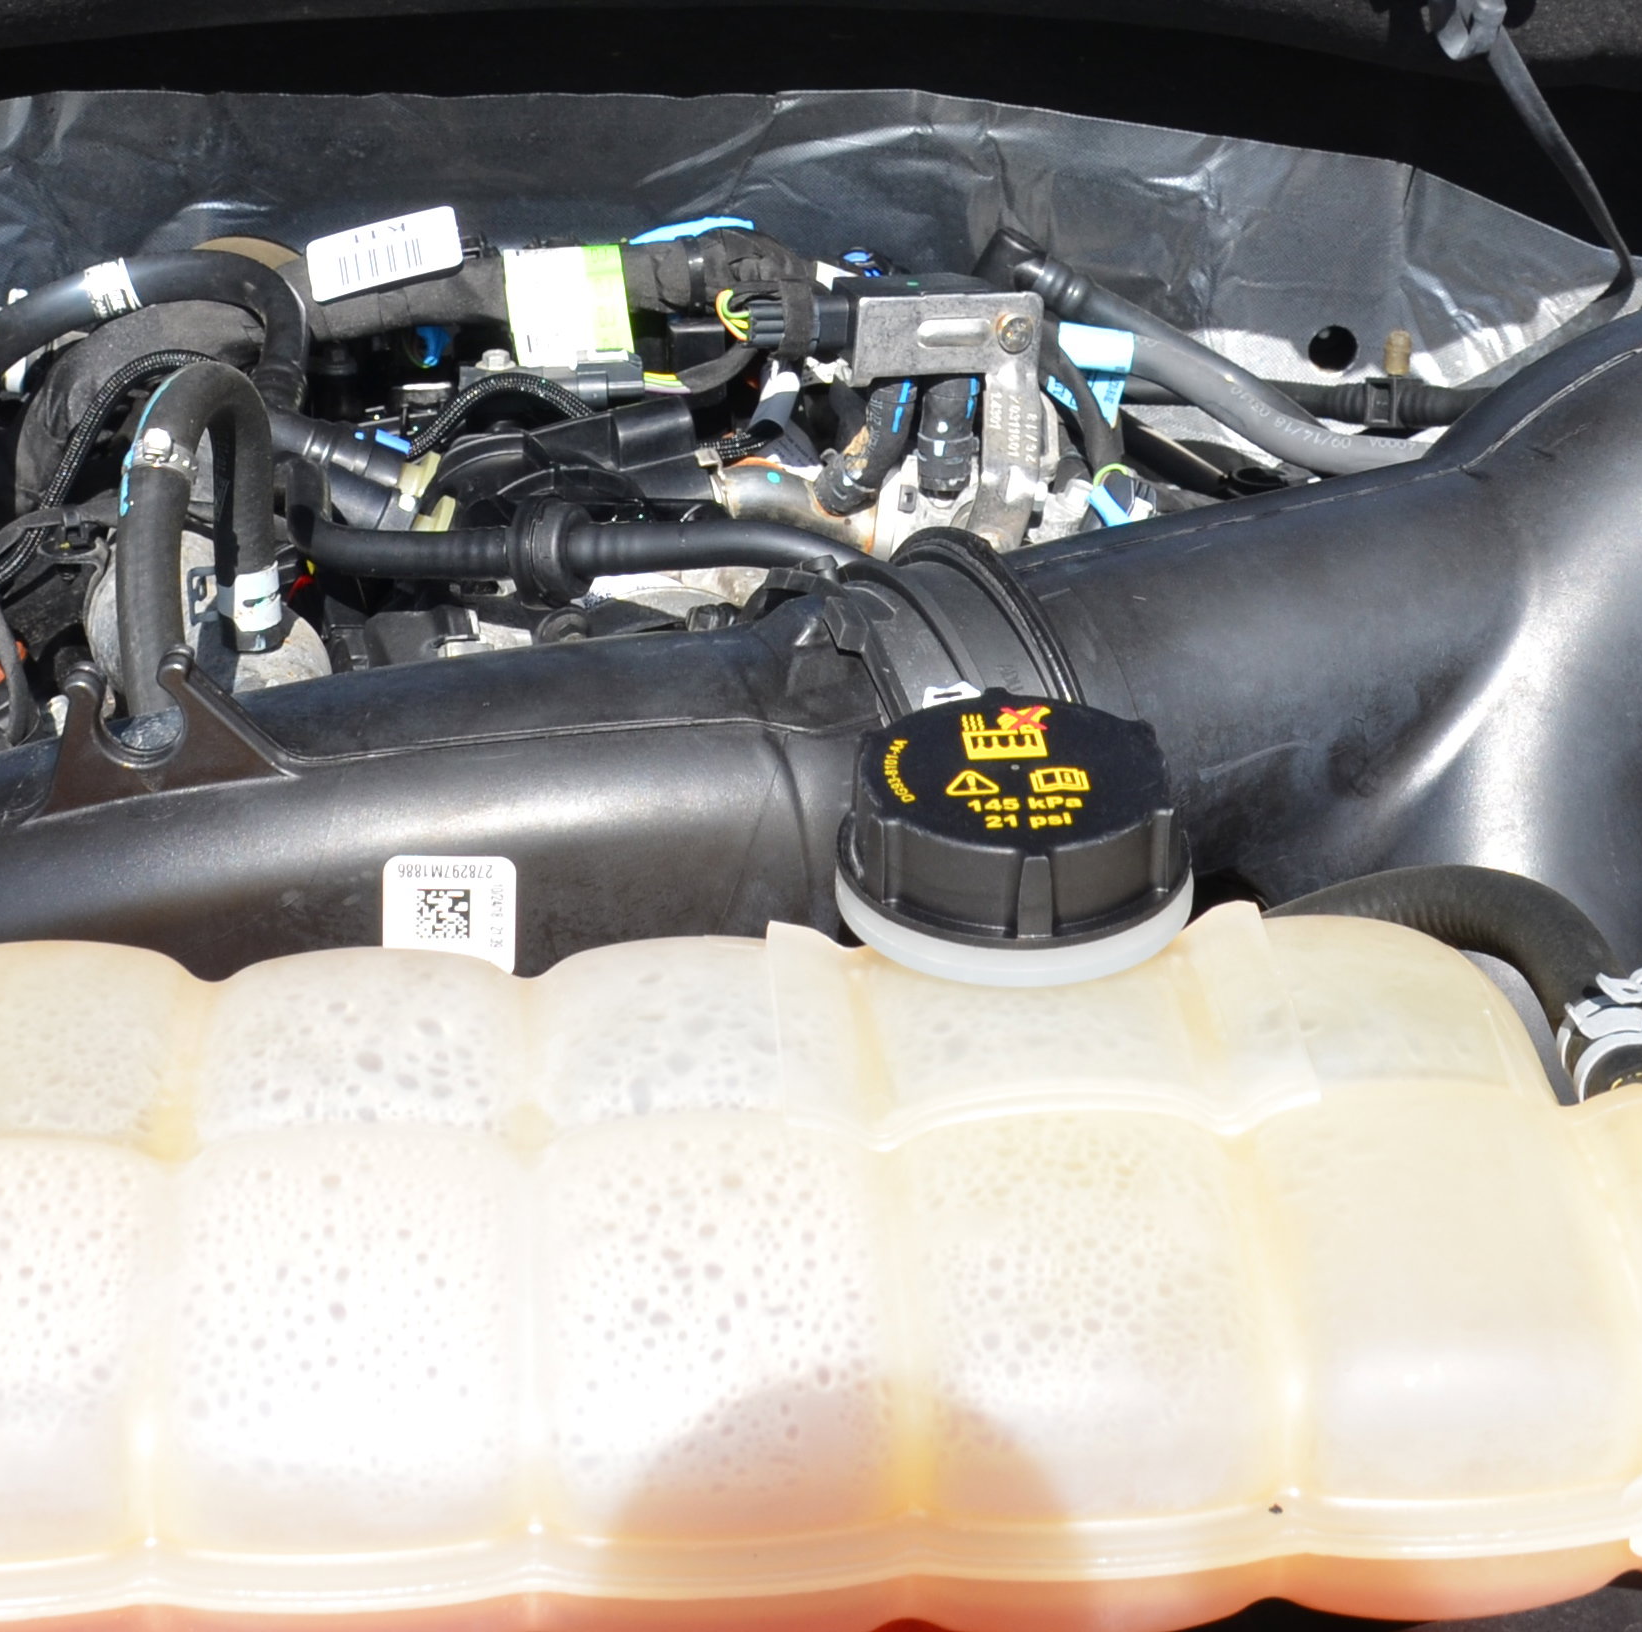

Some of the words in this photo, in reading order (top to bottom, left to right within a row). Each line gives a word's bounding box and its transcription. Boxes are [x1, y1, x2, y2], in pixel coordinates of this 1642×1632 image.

[967, 797, 1020, 813] 145
[1028, 795, 1084, 811] kPa
[984, 814, 1018, 830] 21
[1028, 811, 1073, 830] psi
[397, 863, 493, 879] 278297M1886
